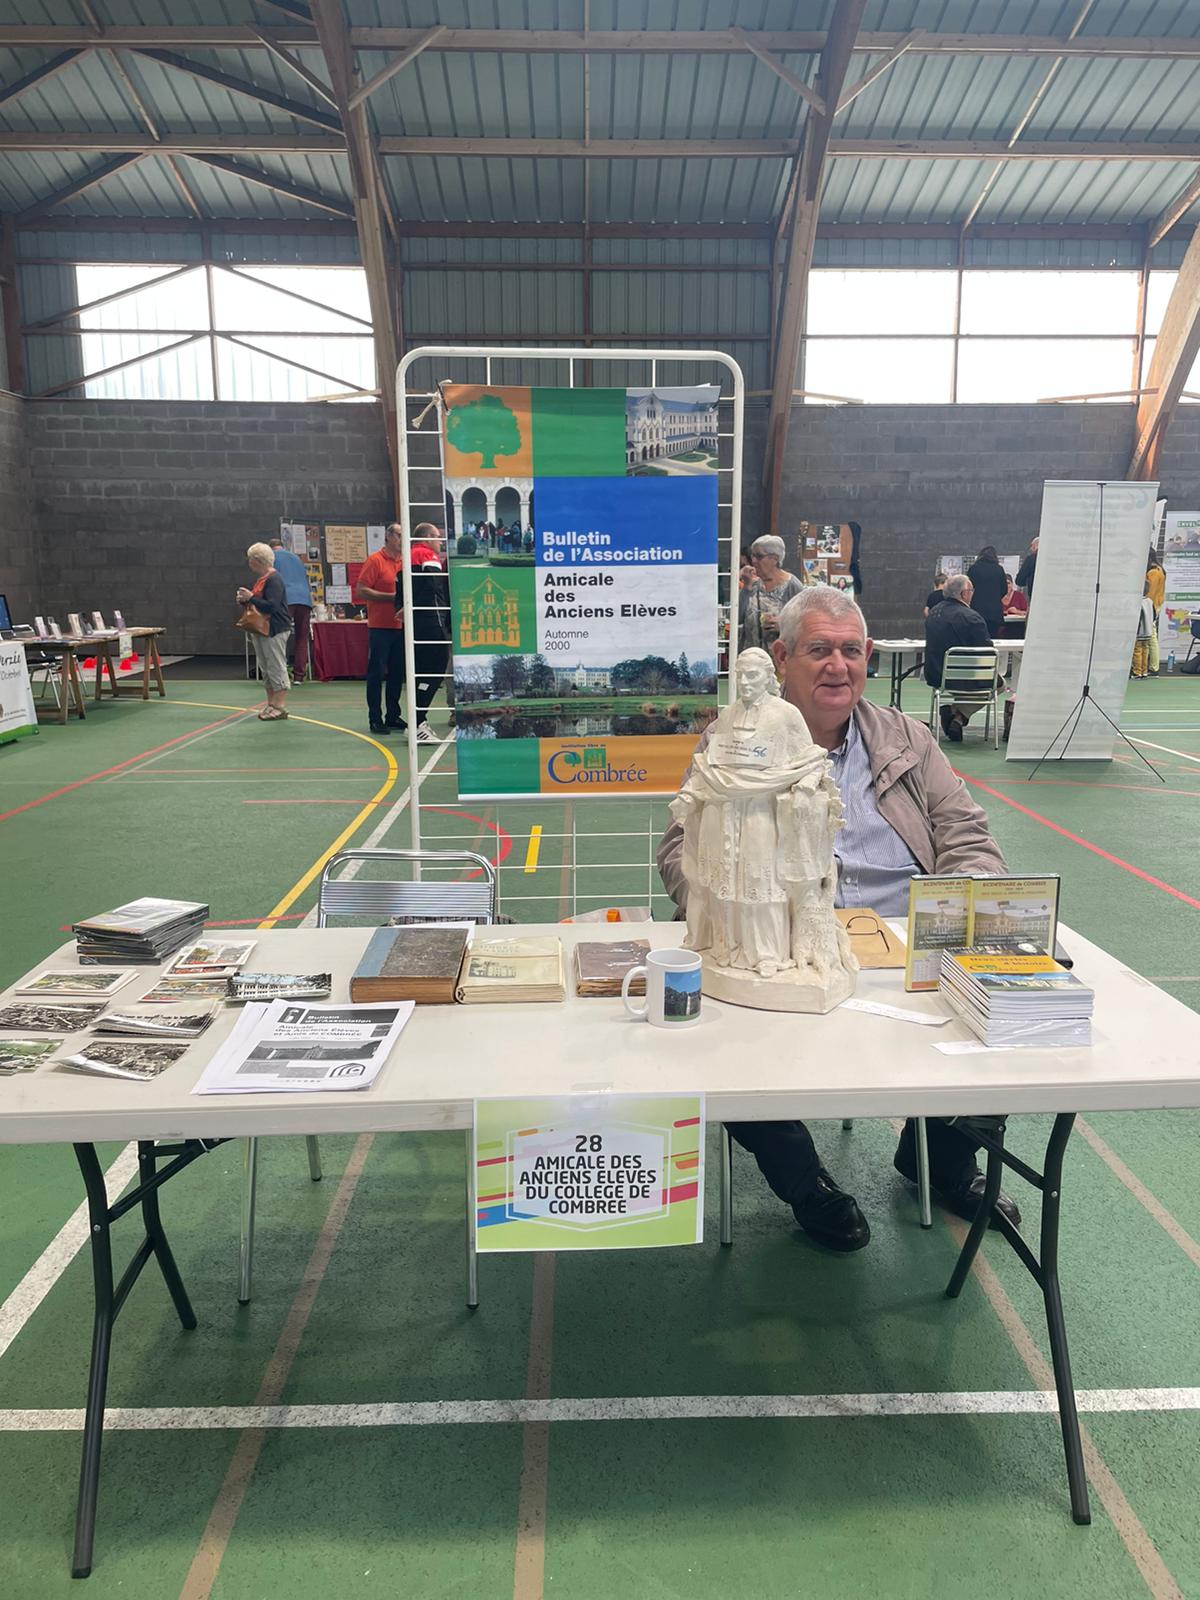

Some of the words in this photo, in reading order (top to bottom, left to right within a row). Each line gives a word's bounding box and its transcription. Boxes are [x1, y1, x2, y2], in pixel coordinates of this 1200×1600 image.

[542, 531, 611, 546] Bulletin
[543, 548, 564, 562] de
[571, 547, 683, 561] l’Association
[544, 573, 614, 586] Amicale
[544, 589, 575, 603] des
[544, 605, 614, 618] Anciens
[620, 603, 677, 617] Elèves
[545, 630, 589, 639] Automne
[545, 641, 570, 650] 2000
[547, 750, 648, 784] Combrée
[575, 1135, 602, 1153] 28
[534, 1155, 605, 1170] AMICALE
[611, 1155, 642, 1169] DES
[519, 1170, 591, 1185] ANCIENS
[597, 1170, 656, 1184] ELEVES
[526, 1185, 549, 1200] DU
[554, 1185, 624, 1200] COLLEGE
[629, 1184, 650, 1199] DE
[549, 1200, 627, 1214] COMBREE
